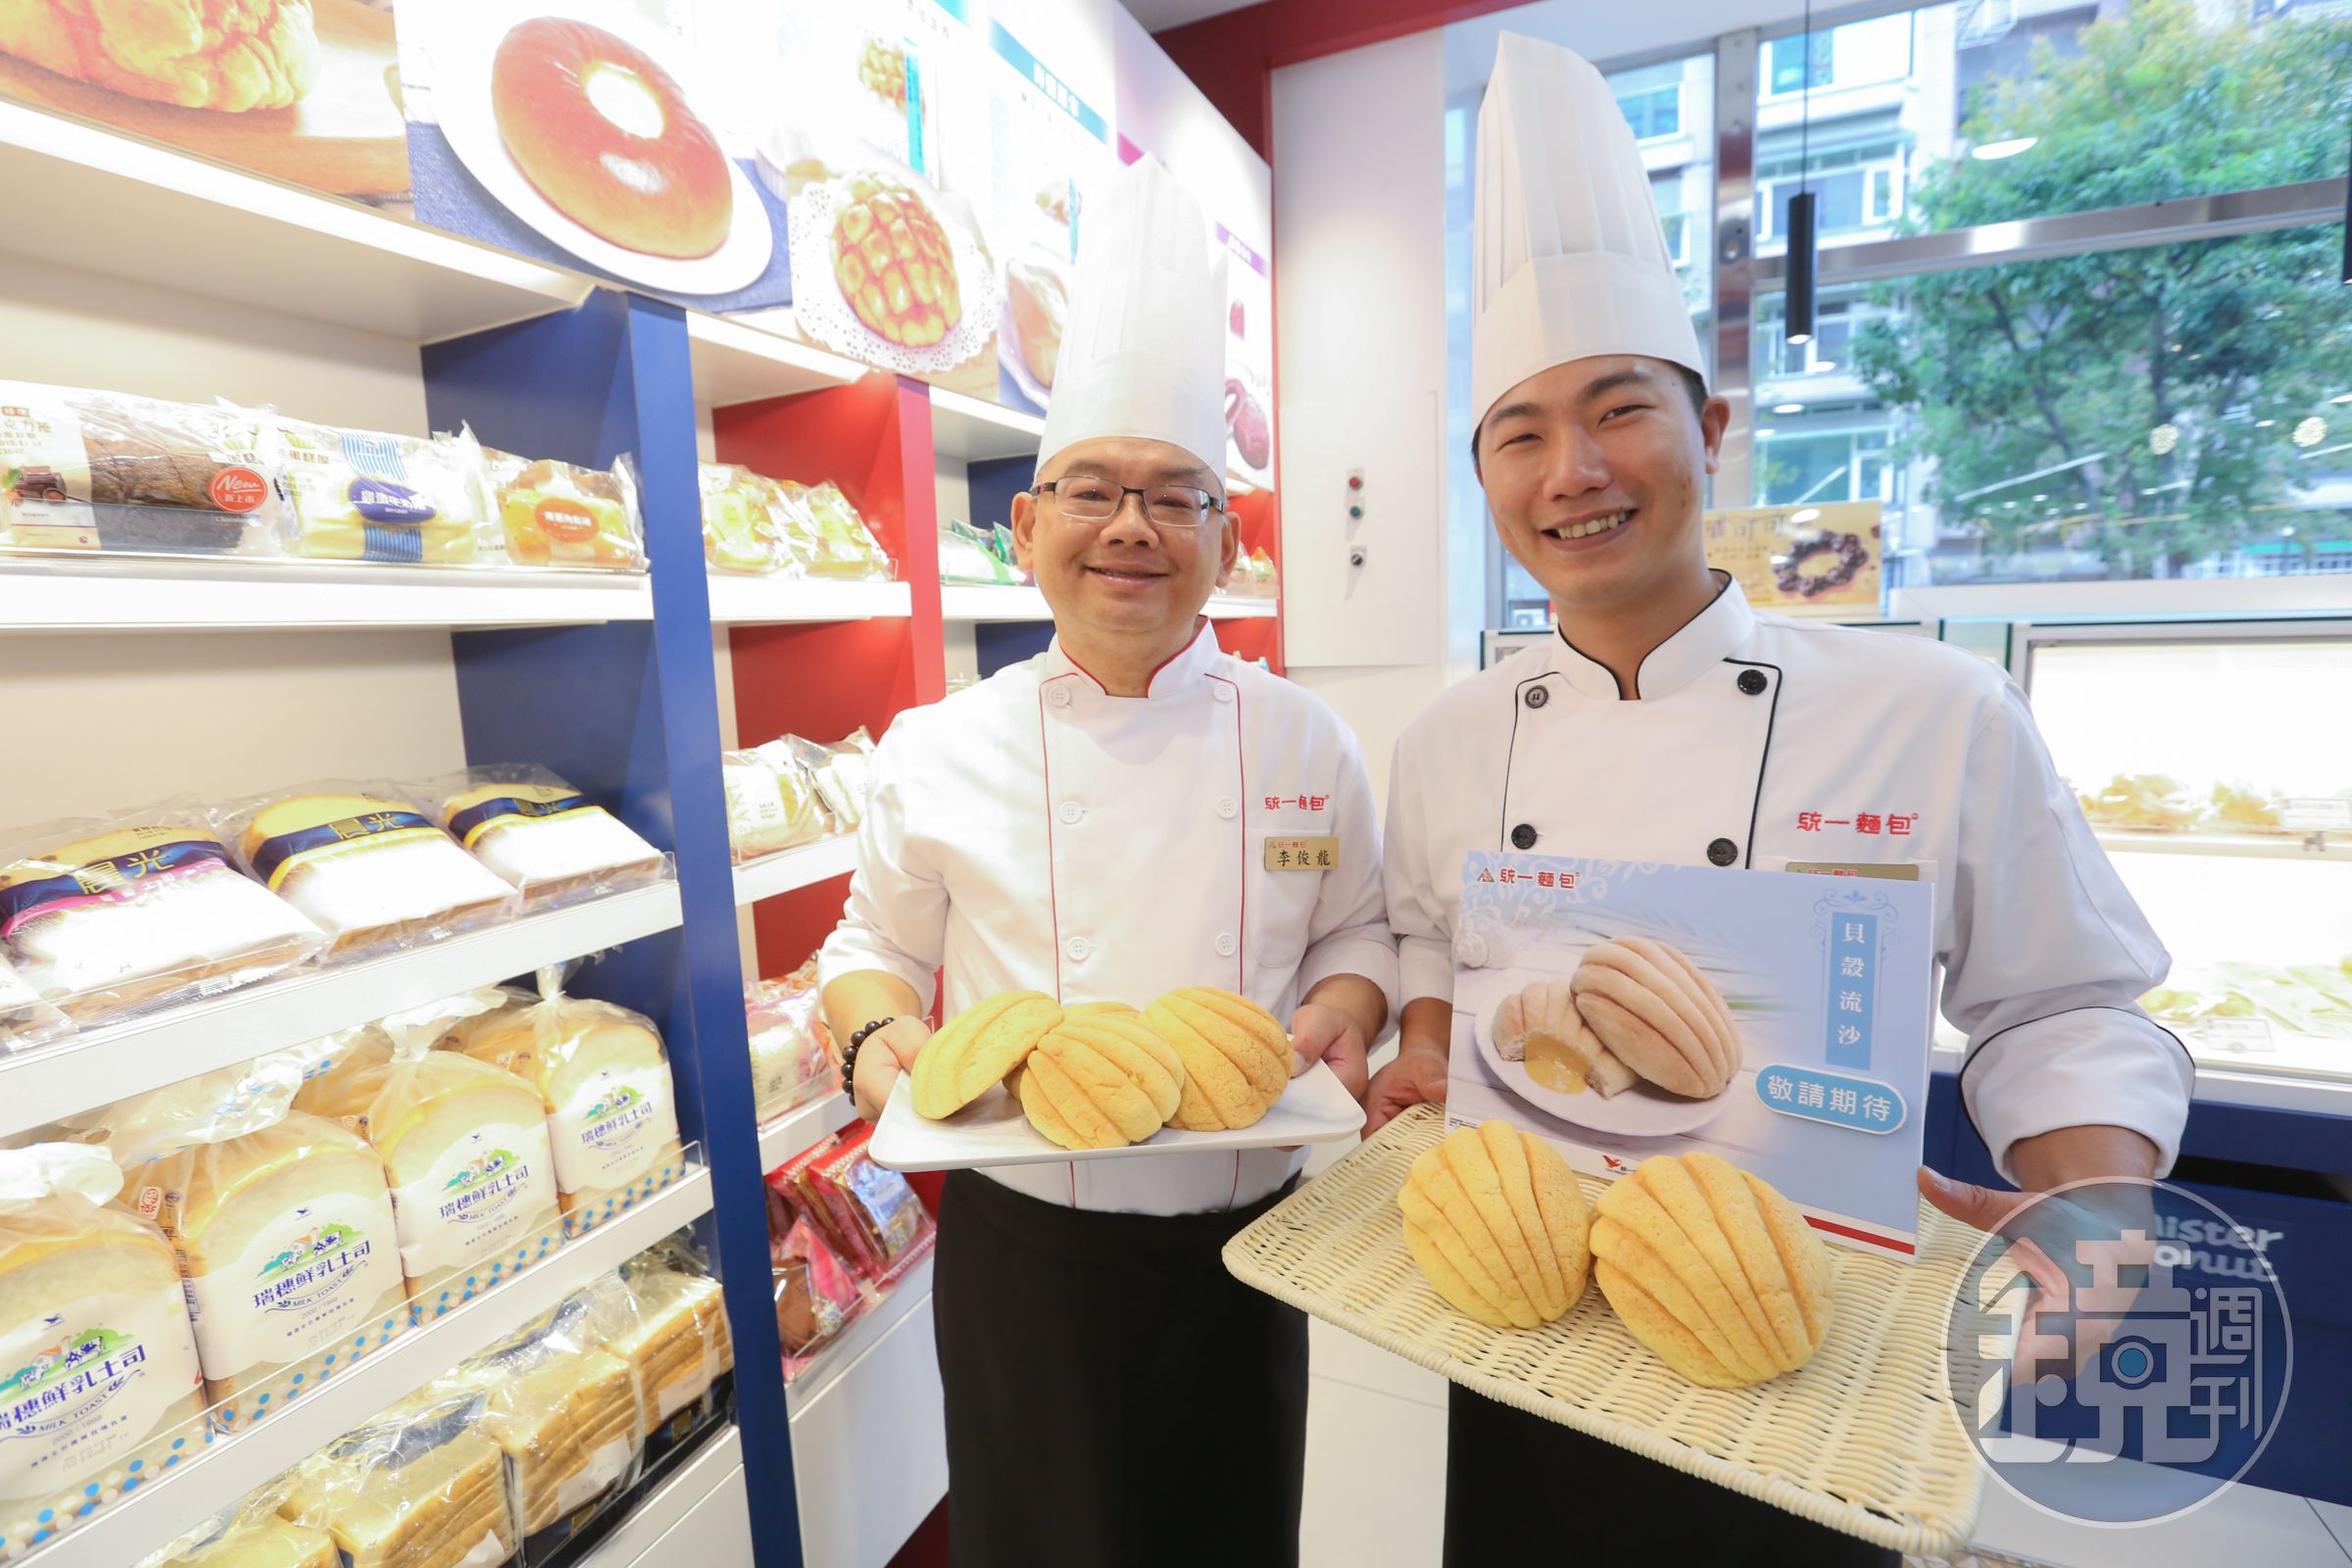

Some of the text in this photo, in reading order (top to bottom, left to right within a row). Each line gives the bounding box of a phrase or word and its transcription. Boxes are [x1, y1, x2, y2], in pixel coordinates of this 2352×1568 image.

[216, 474, 261, 493] New
[1797, 811, 1911, 835] 統一麵包
[1277, 850, 1331, 867] 李俊龍
[1499, 868, 1575, 889] 統一麵包
[1838, 921, 1866, 1045] 貝殼流沙
[1767, 1074, 1891, 1122] 敬請期待
[438, 1164, 529, 1219] 瑞穗鮮乳土司
[252, 1240, 371, 1309] 瑞穗鮮乳土司
[2154, 1245, 2279, 1283] onut
[74, 1393, 109, 1420] TOAST
